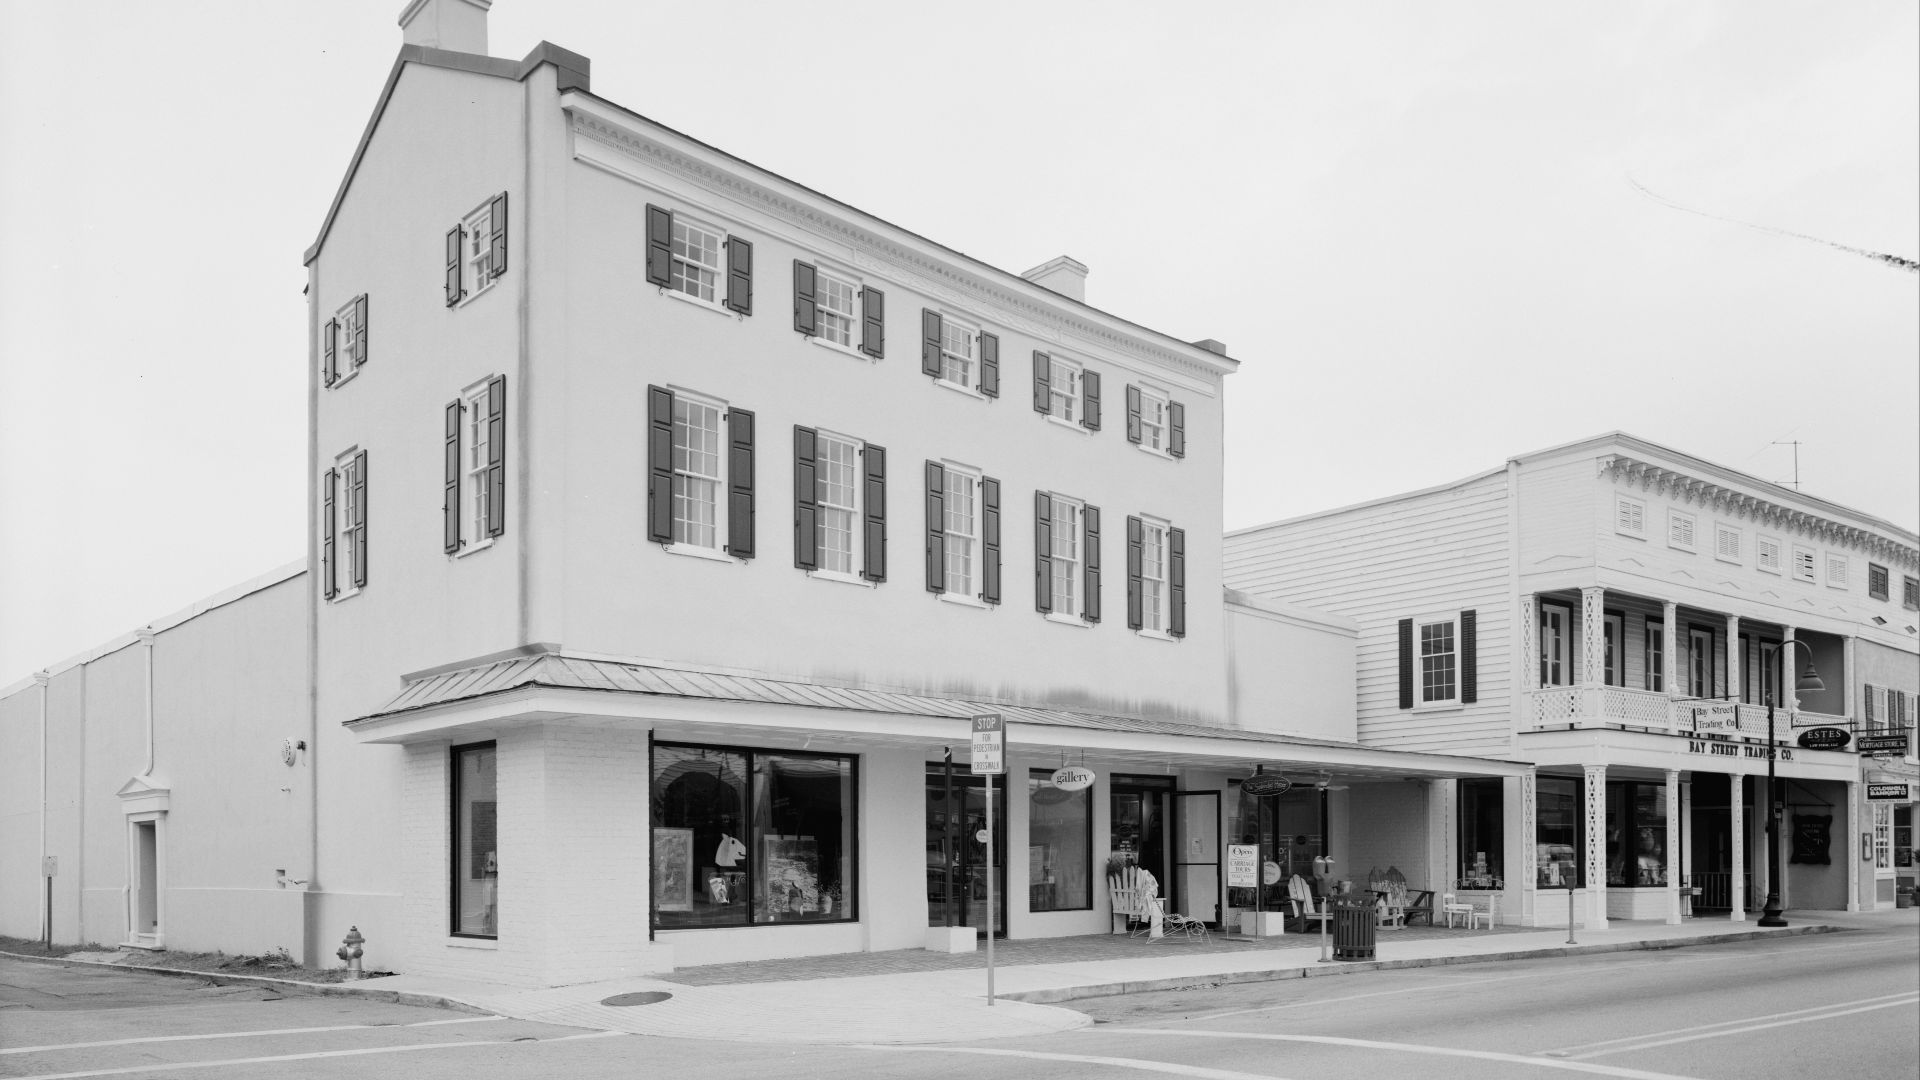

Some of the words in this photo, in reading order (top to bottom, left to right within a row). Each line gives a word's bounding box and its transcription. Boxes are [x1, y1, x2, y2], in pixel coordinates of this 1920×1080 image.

[1696, 707, 1708, 718] Bay
[1711, 705, 1734, 715] Street
[977, 717, 996, 730] STOP
[1697, 720, 1723, 730] Trading
[982, 733, 992, 743] FOR
[1807, 730, 1841, 739] ESTES
[973, 743, 1000, 753] PEDESTRIAN
[1689, 740, 1706, 753] BAY
[1711, 743, 1739, 756] STREET
[1781, 749, 1794, 760] CO.
[973, 761, 1000, 771] CROSSWALK
[1056, 771, 1088, 785] gallery
[1232, 847, 1253, 857] Open
